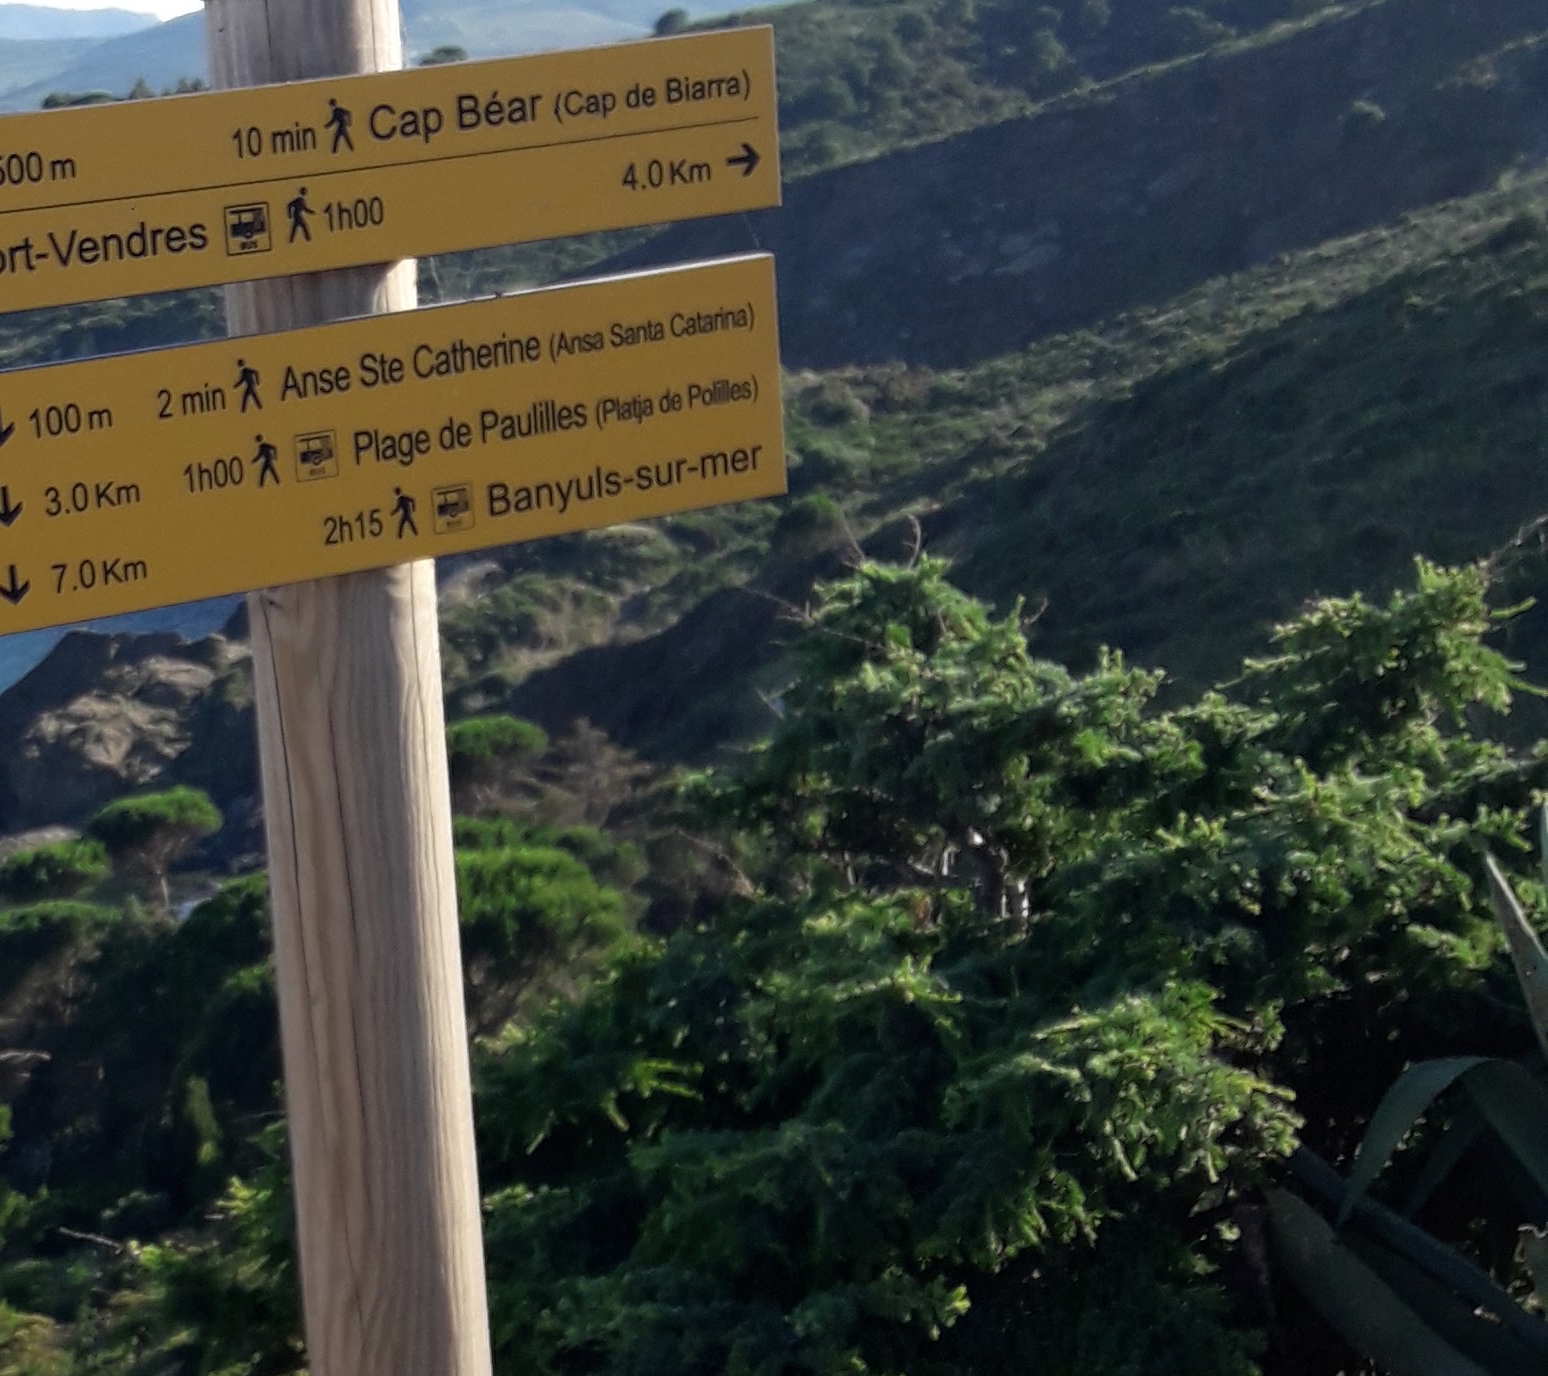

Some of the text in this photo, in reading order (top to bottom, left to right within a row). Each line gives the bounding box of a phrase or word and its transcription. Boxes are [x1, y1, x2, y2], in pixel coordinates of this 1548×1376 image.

[232, 70, 750, 159] 10 min Cap Béar (Cap de Biarra)
[50, 158, 76, 181] m
[622, 159, 711, 191] 4.0 Km
[323, 196, 384, 232] 1h00
[157, 302, 754, 419] 2 min Anse Ste Catherine (Ansa Santa Catarina)
[29, 403, 113, 439] 100 m
[183, 456, 244, 493] 1h00
[353, 429, 431, 467] Plage
[439, 417, 472, 450] de
[480, 399, 588, 444] Paulilles
[659, 390, 682, 414] de
[44, 481, 141, 517] 3.0 Km
[323, 445, 764, 546] 2h15 Banyuls-sur-mer
[51, 558, 147, 594] 7.0 Km
